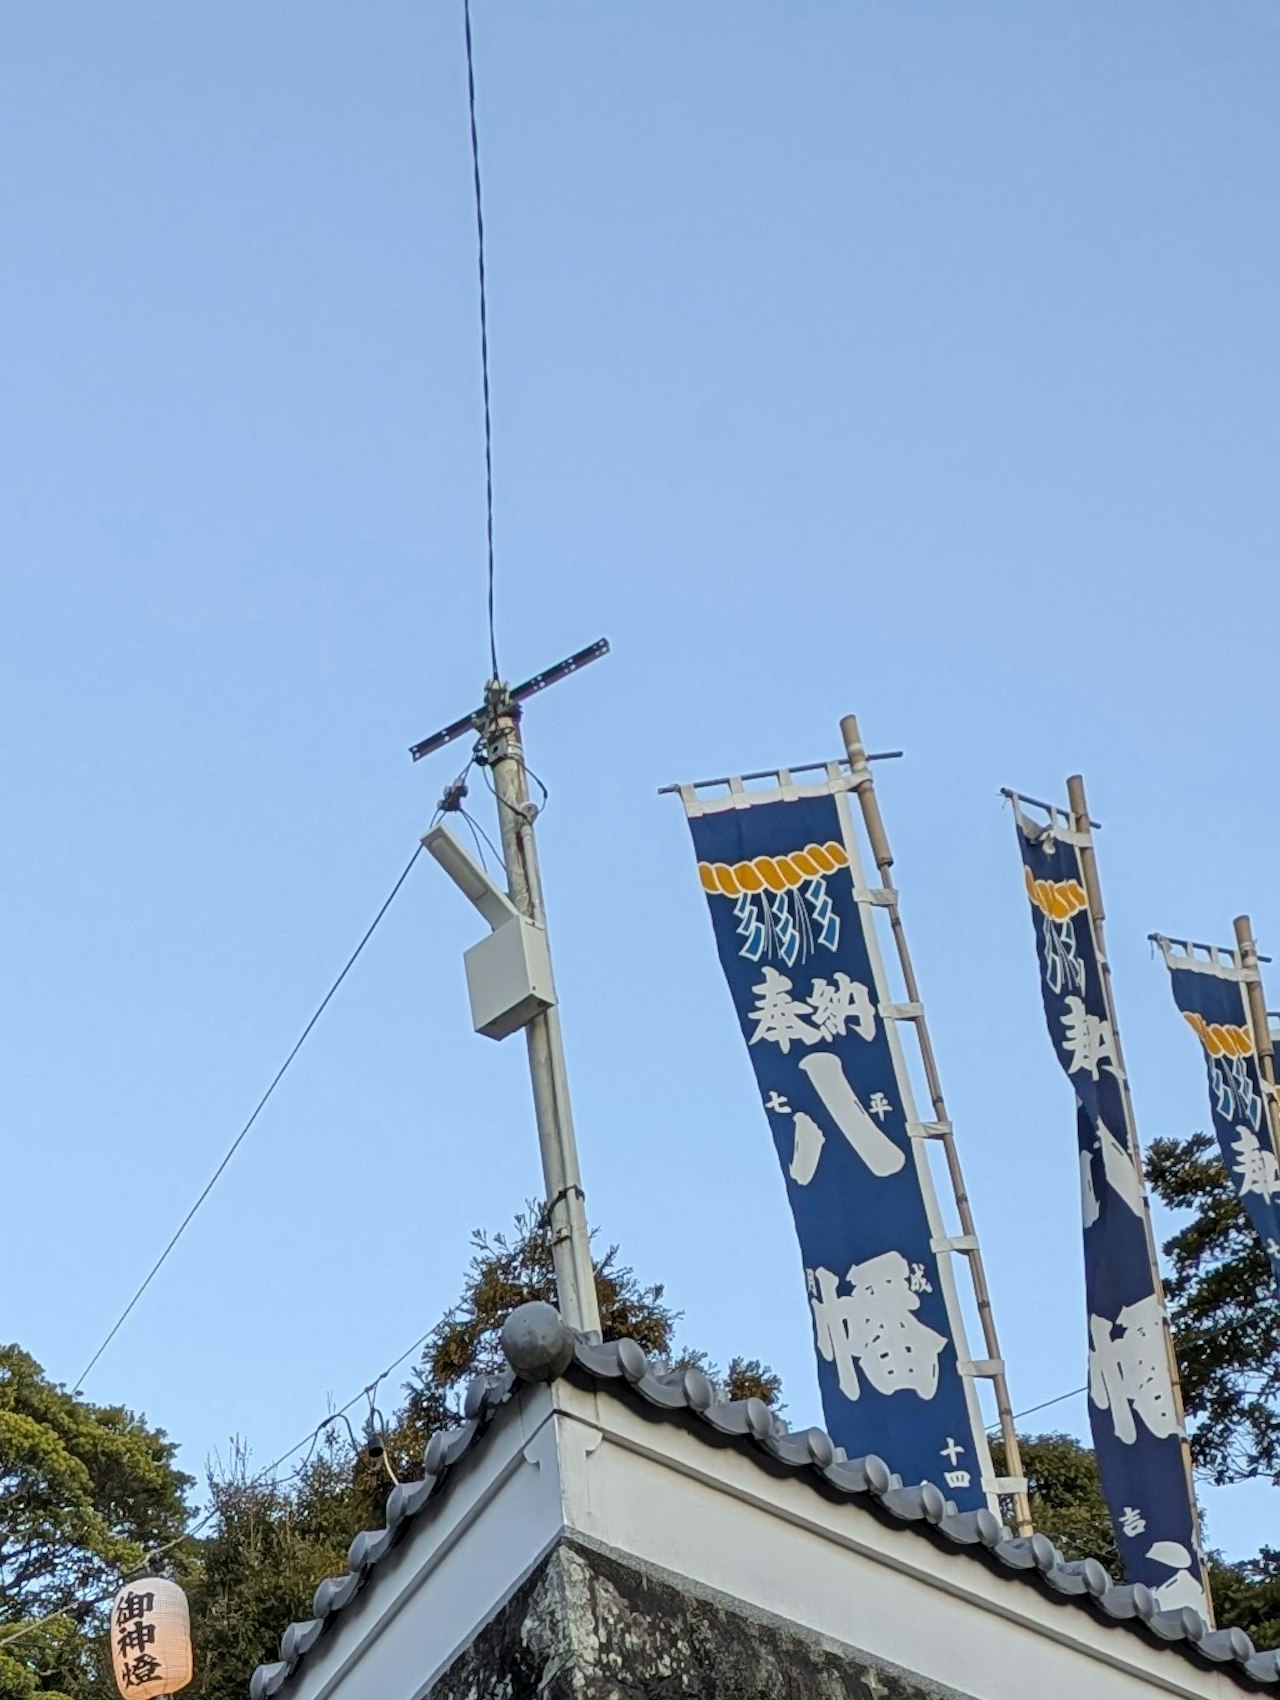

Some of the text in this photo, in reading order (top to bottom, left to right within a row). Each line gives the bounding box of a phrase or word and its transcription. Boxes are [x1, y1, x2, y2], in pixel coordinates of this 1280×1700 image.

[747, 965, 876, 1054] 奉納
[116, 1591, 163, 1690] 御神燈
